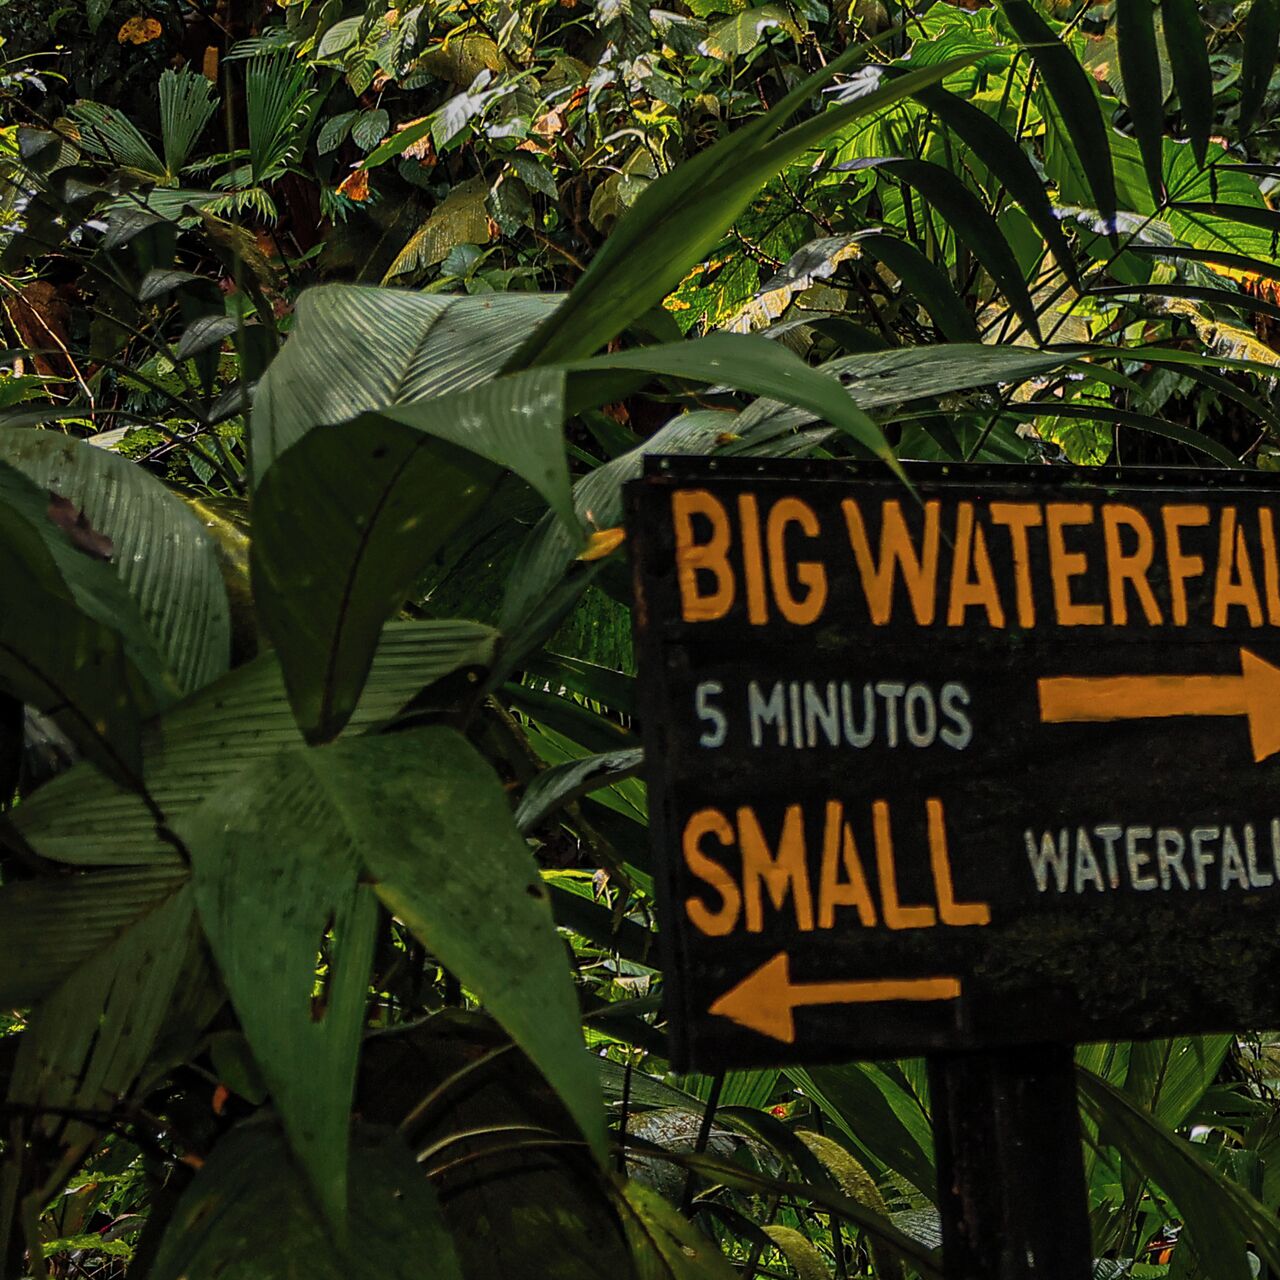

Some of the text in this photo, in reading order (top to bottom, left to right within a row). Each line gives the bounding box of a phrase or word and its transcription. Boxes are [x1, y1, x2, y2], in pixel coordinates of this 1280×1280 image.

[672, 488, 828, 626] BIG
[695, 681, 973, 750] 5 MINUTOS
[682, 799, 991, 936] SMALL
